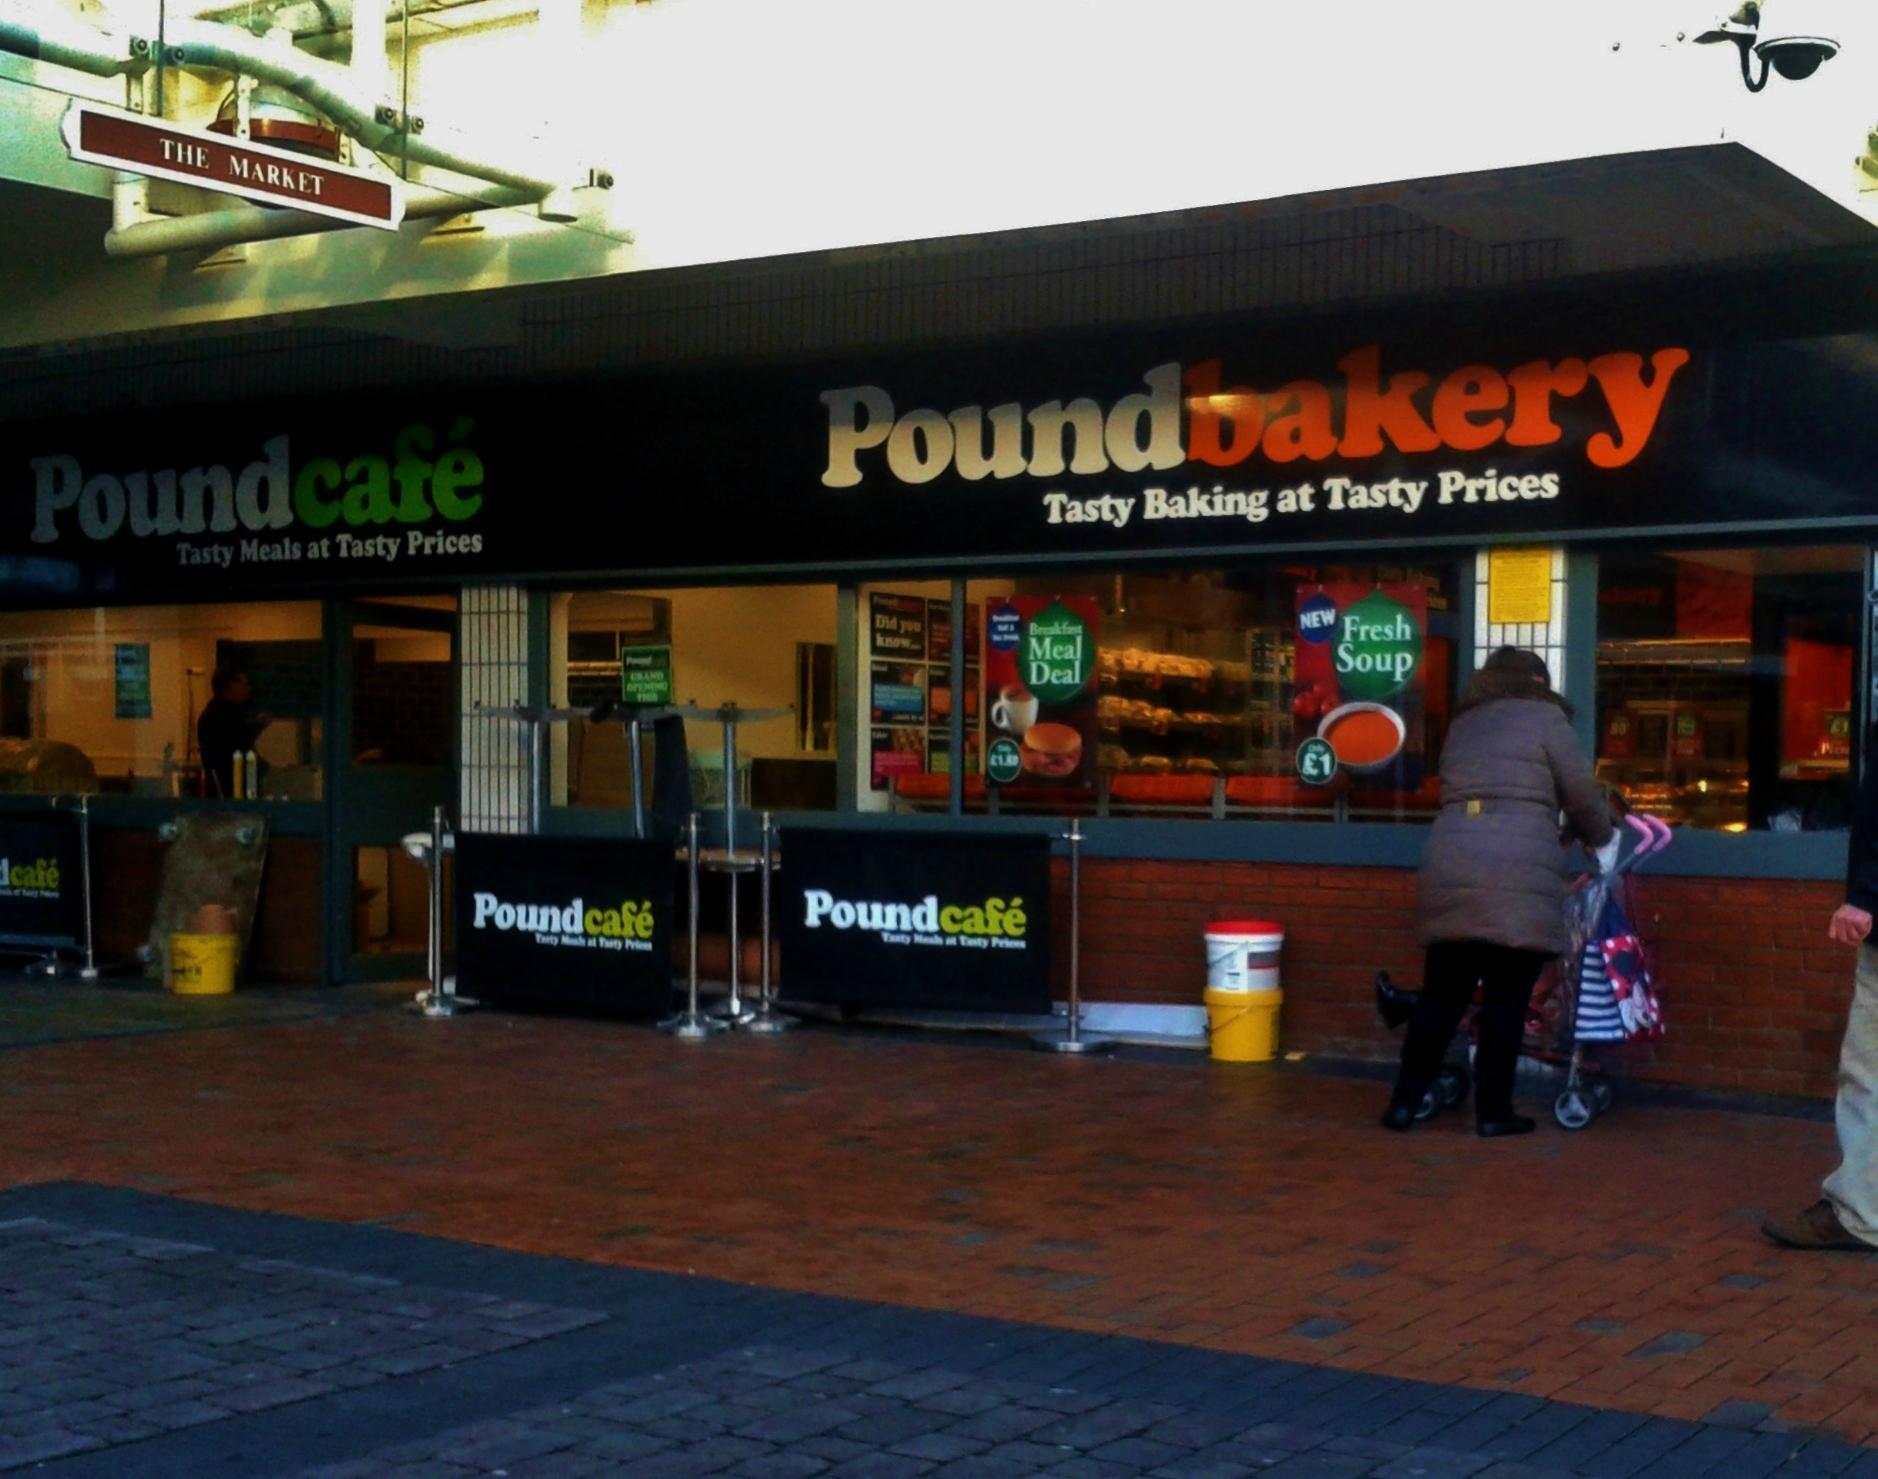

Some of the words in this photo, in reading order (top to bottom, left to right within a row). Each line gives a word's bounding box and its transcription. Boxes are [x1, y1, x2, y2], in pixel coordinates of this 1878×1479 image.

[160, 138, 209, 169] THE
[229, 154, 324, 195] MARKET
[820, 344, 1691, 487] Poundbakery
[30, 416, 484, 543] Poundcafé
[1042, 492, 1136, 527] Tasty
[1143, 485, 1269, 523] Baking
[1277, 482, 1315, 513] at
[1322, 476, 1427, 514] Tasty
[1437, 468, 1560, 504] Prices
[177, 541, 235, 568] Tasty
[239, 537, 302, 563] Meals
[307, 538, 330, 560] at
[335, 533, 401, 561] Tasty
[407, 529, 483, 556] Prices
[1028, 622, 1083, 636] Breakfast
[1299, 608, 1336, 630] NEW
[1343, 613, 1412, 642] Fresh
[1028, 635, 1083, 660] Meal
[1336, 643, 1414, 681] Soup
[1029, 660, 1082, 686] Deal
[1303, 754, 1332, 777] £1
[473, 892, 655, 939] Poundcafé
[803, 888, 1027, 936] Poundcafé
